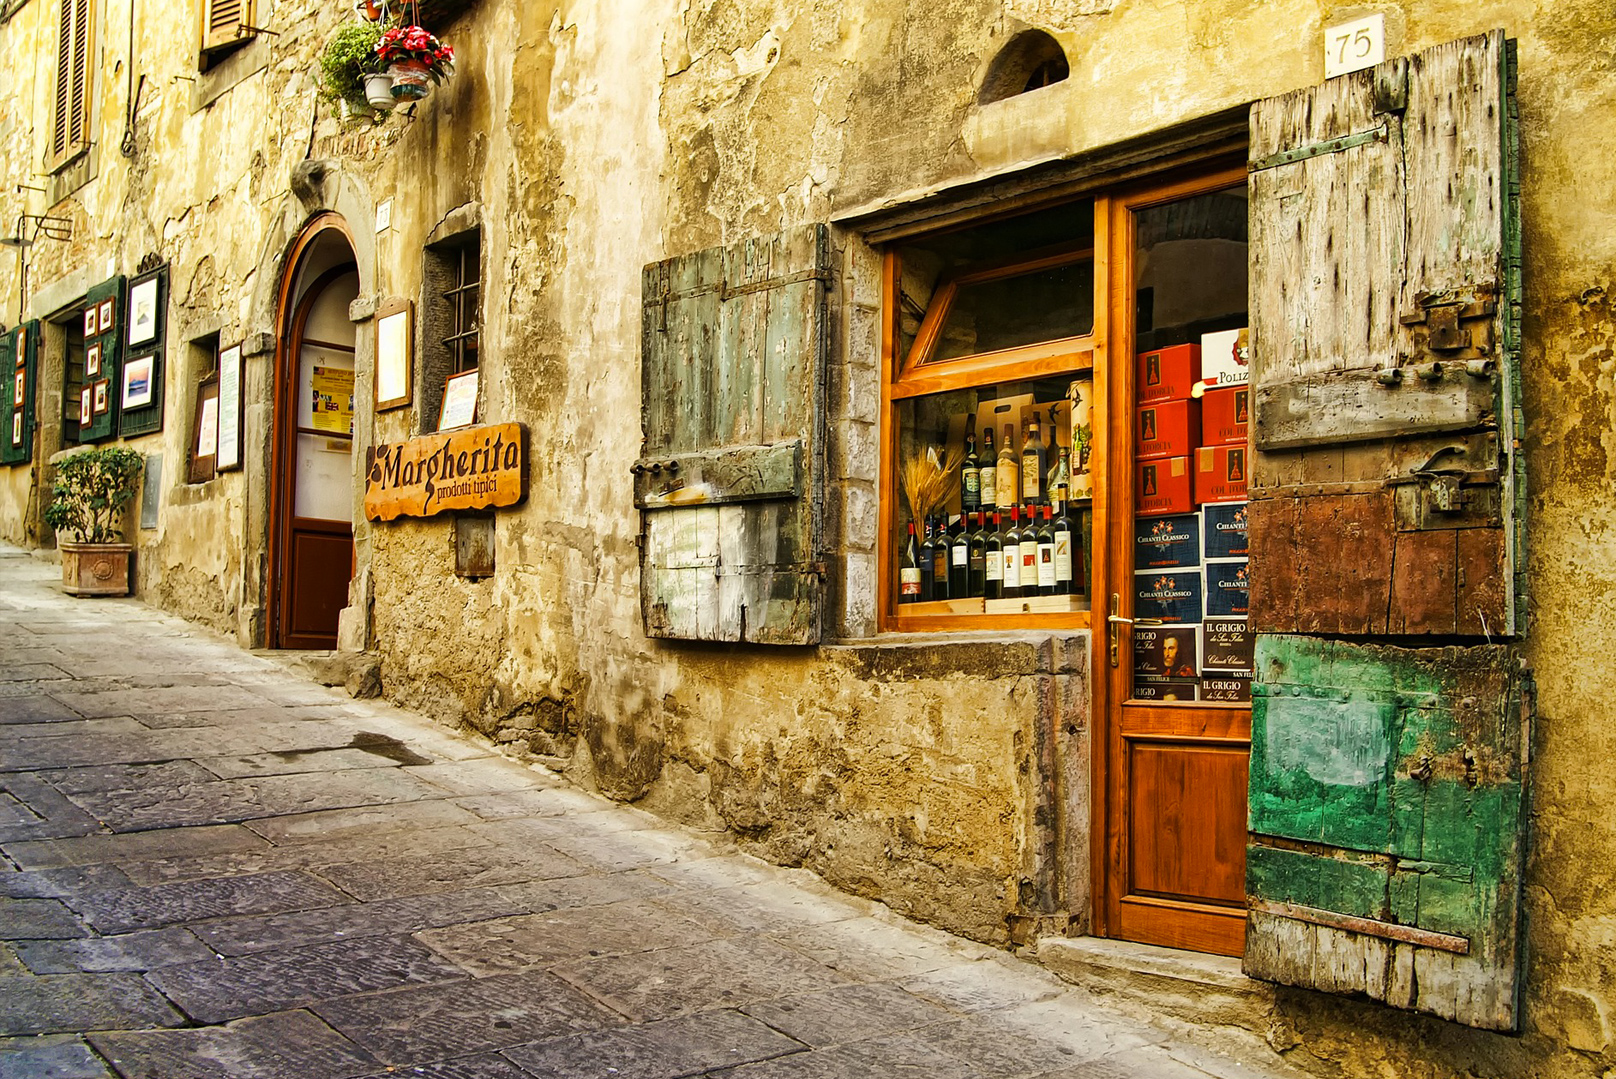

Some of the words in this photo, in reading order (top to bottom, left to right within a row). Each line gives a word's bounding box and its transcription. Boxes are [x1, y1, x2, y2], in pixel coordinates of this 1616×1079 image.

[1335, 27, 1372, 64] 75
[381, 432, 518, 515] Margherita
[436, 477, 472, 504] prodotti
[473, 474, 498, 498] tipici
[1206, 623, 1214, 632] IL
[1215, 623, 1246, 633] GRIGIO
[1203, 681, 1211, 690] IL
[1211, 681, 1241, 690] GRIGIO
